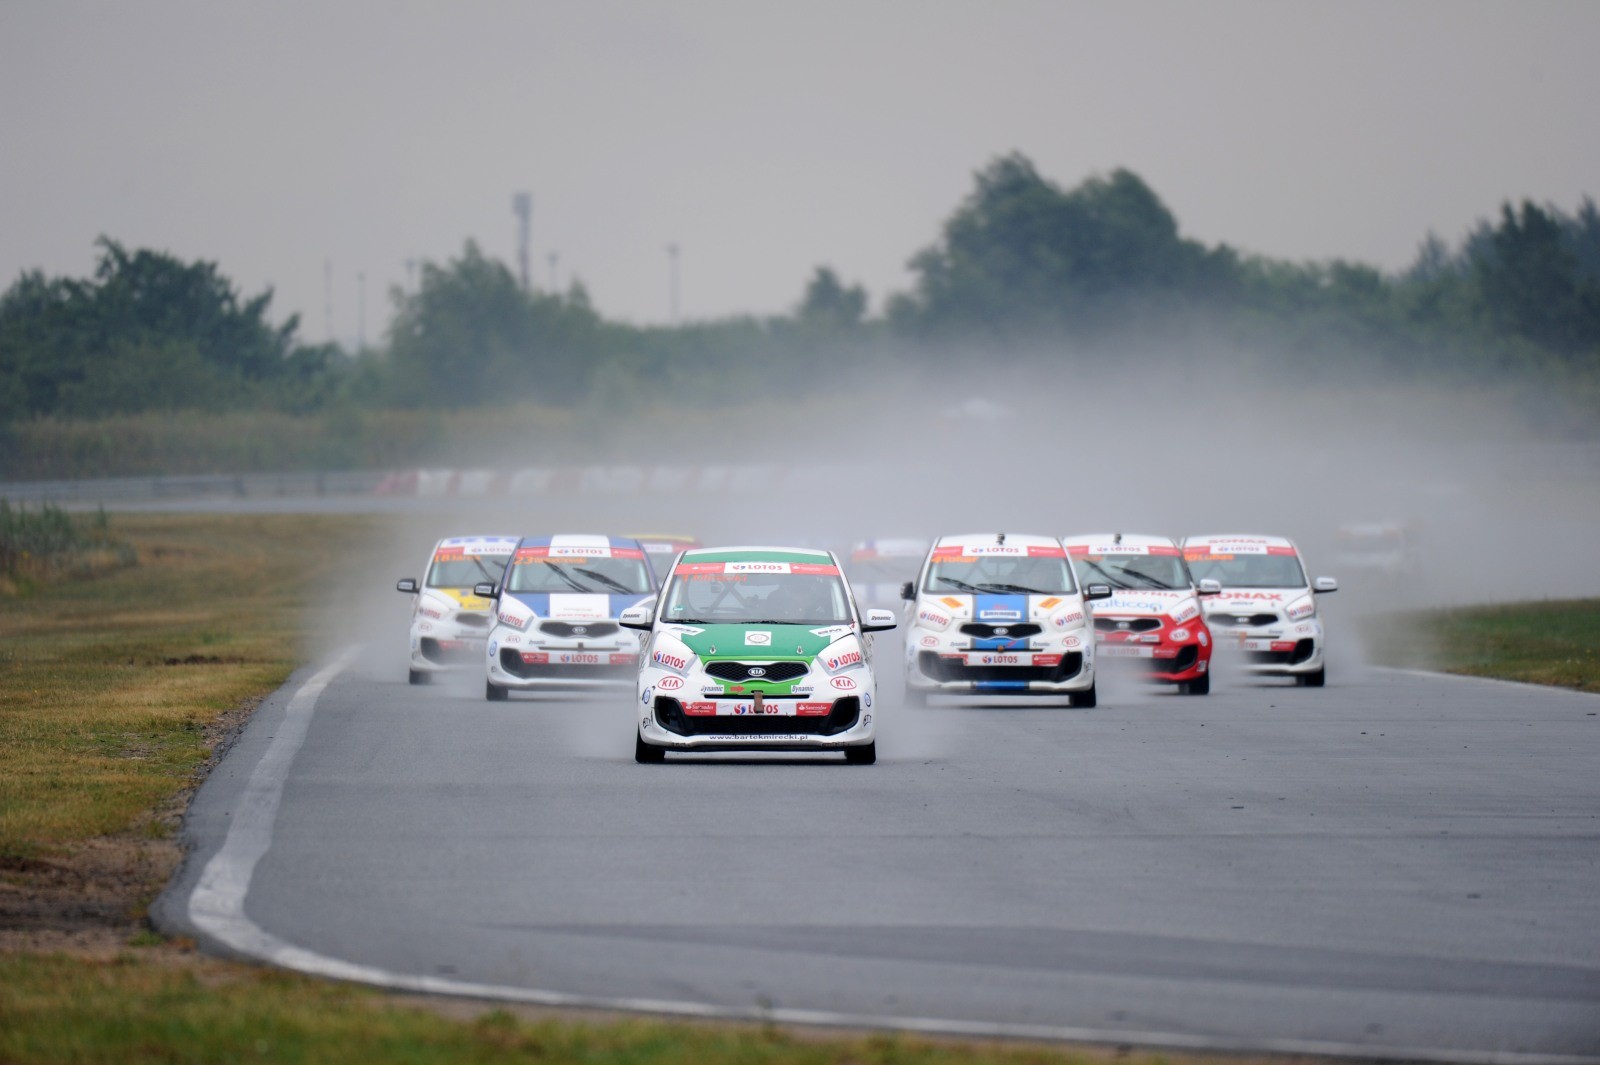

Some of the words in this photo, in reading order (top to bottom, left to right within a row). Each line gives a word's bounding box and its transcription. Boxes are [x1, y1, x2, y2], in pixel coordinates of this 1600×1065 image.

[505, 615, 524, 627] LOTOS
[926, 612, 949, 626] LOTOS
[1064, 611, 1083, 624] LOTOS
[571, 655, 599, 664] LOTOS
[661, 654, 685, 669] LOTOS
[838, 652, 860, 665] LOTOS
[751, 668, 763, 676] KIA
[661, 679, 679, 688] KIA
[835, 679, 853, 688] KIA
[748, 704, 779, 714] LOS
